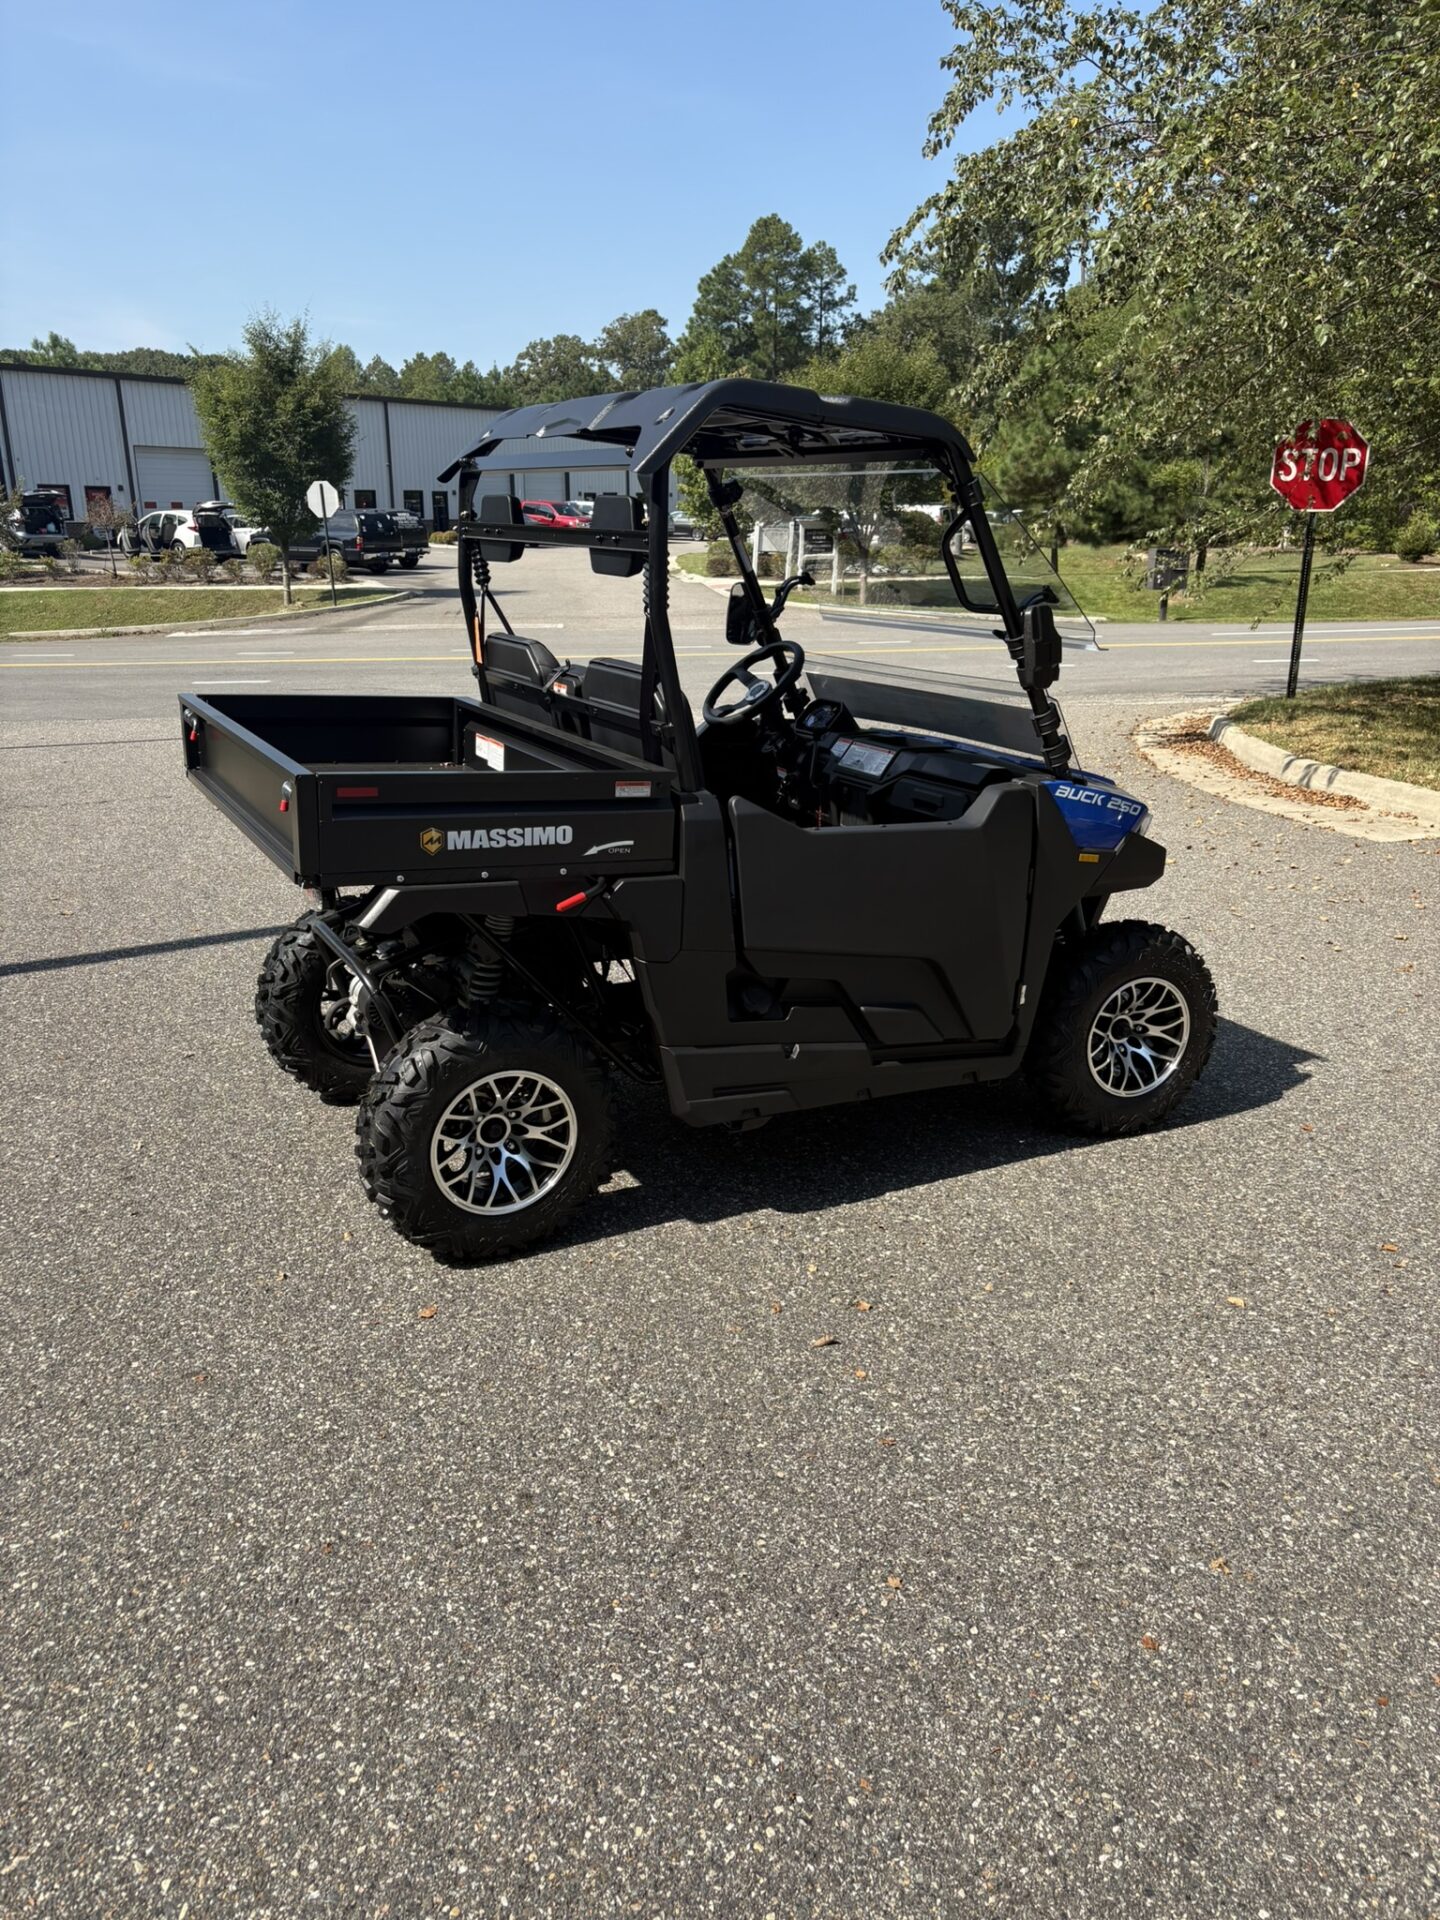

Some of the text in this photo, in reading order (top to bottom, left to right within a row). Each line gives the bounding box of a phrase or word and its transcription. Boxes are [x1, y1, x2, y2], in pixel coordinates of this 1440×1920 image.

[1278, 447, 1362, 482] STOP
[1055, 785, 1141, 816] BUCK 250
[447, 825, 573, 850] MASSIMO
